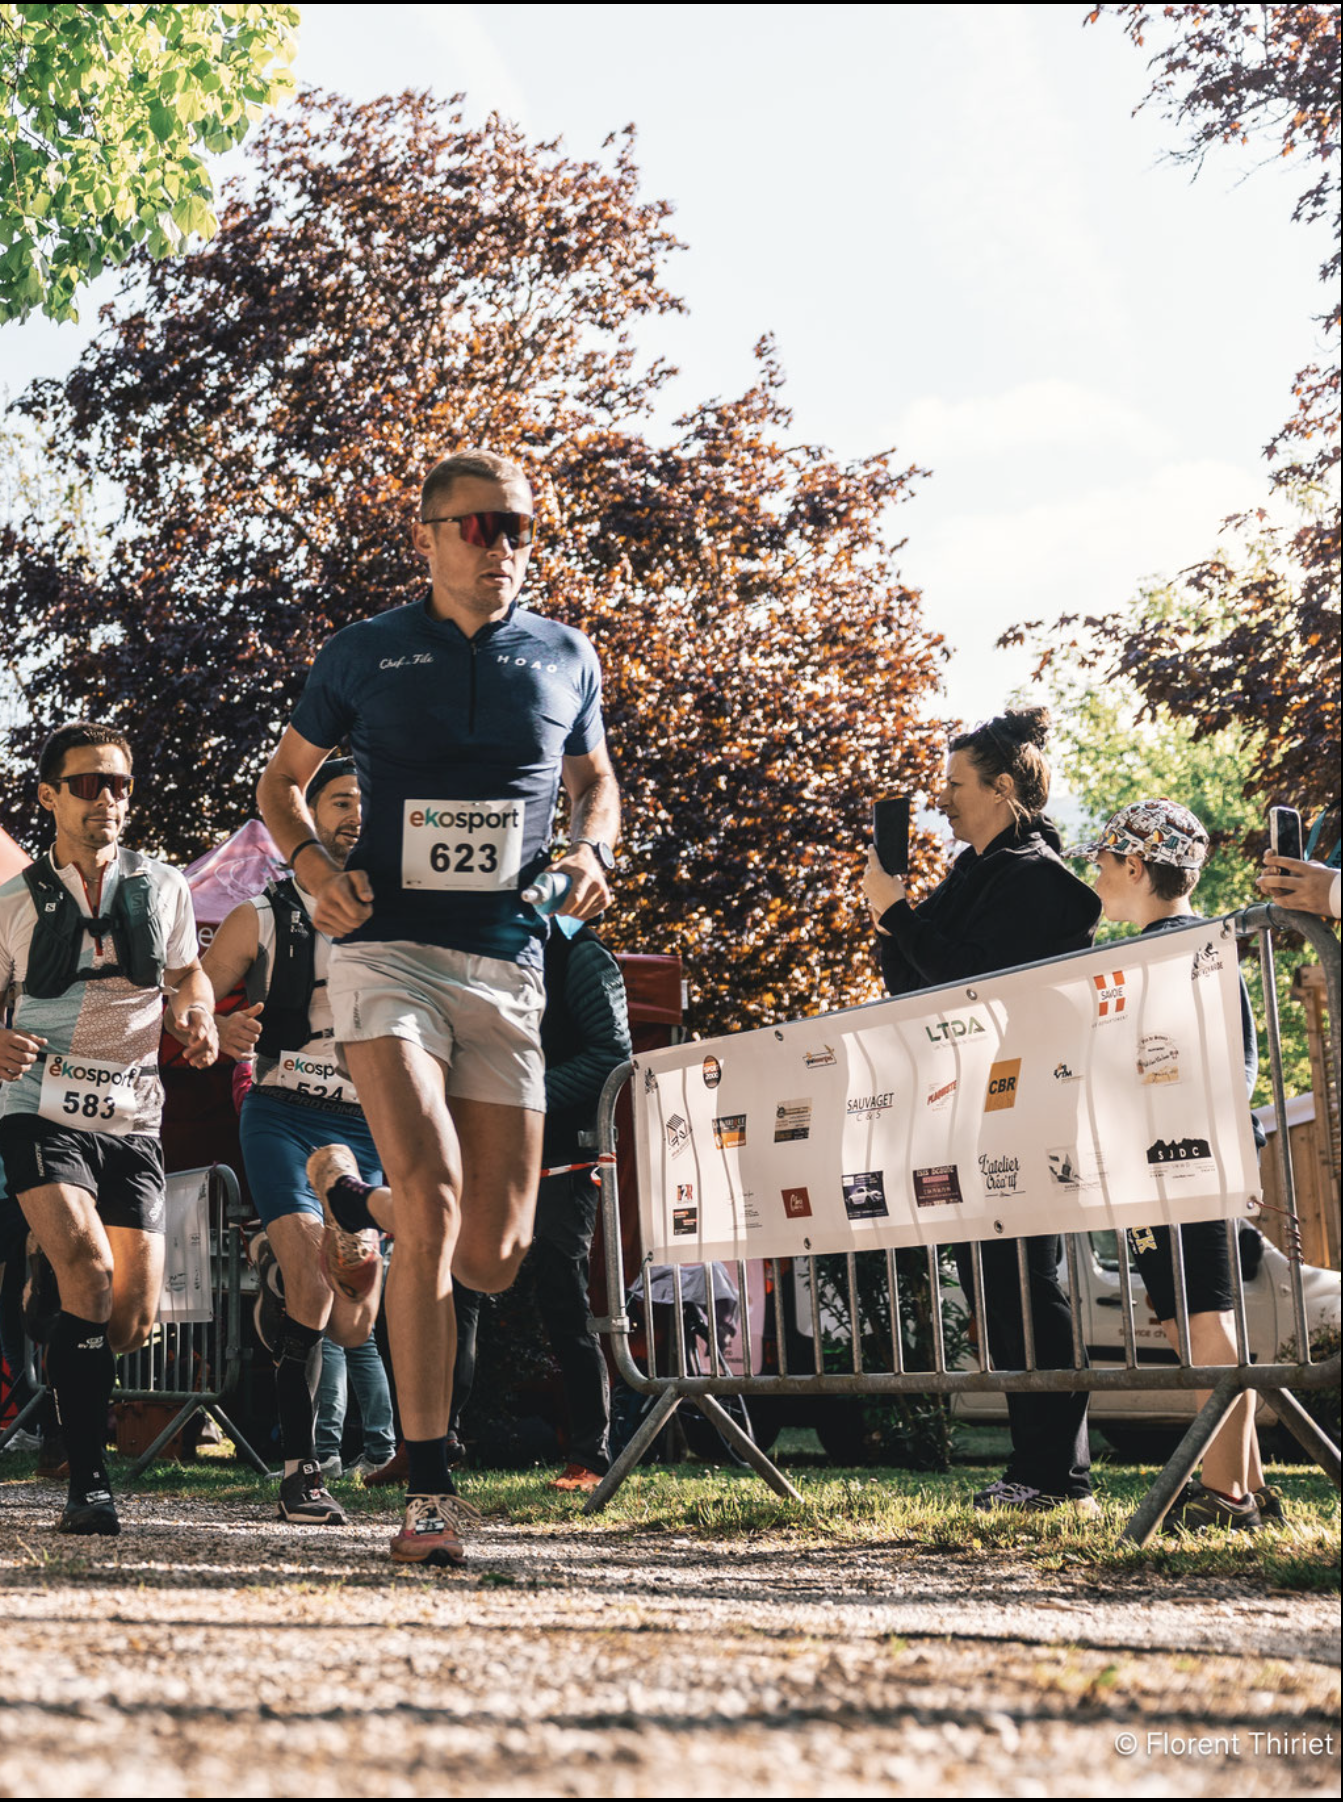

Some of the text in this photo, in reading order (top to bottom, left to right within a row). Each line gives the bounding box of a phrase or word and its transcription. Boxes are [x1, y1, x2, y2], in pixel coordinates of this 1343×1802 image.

[409, 807, 519, 834] ekosport
[430, 843, 498, 873] 623
[1101, 987, 1123, 1000] SAVOIE
[925, 1016, 986, 1042] LTDA
[48, 1061, 136, 1088] ekosport
[283, 1057, 336, 1080] ekosp
[988, 1076, 1017, 1095] CBR
[62, 1091, 117, 1120] 583
[846, 1092, 895, 1112] SAUVAGET
[1157, 1146, 1201, 1161] SJDC
